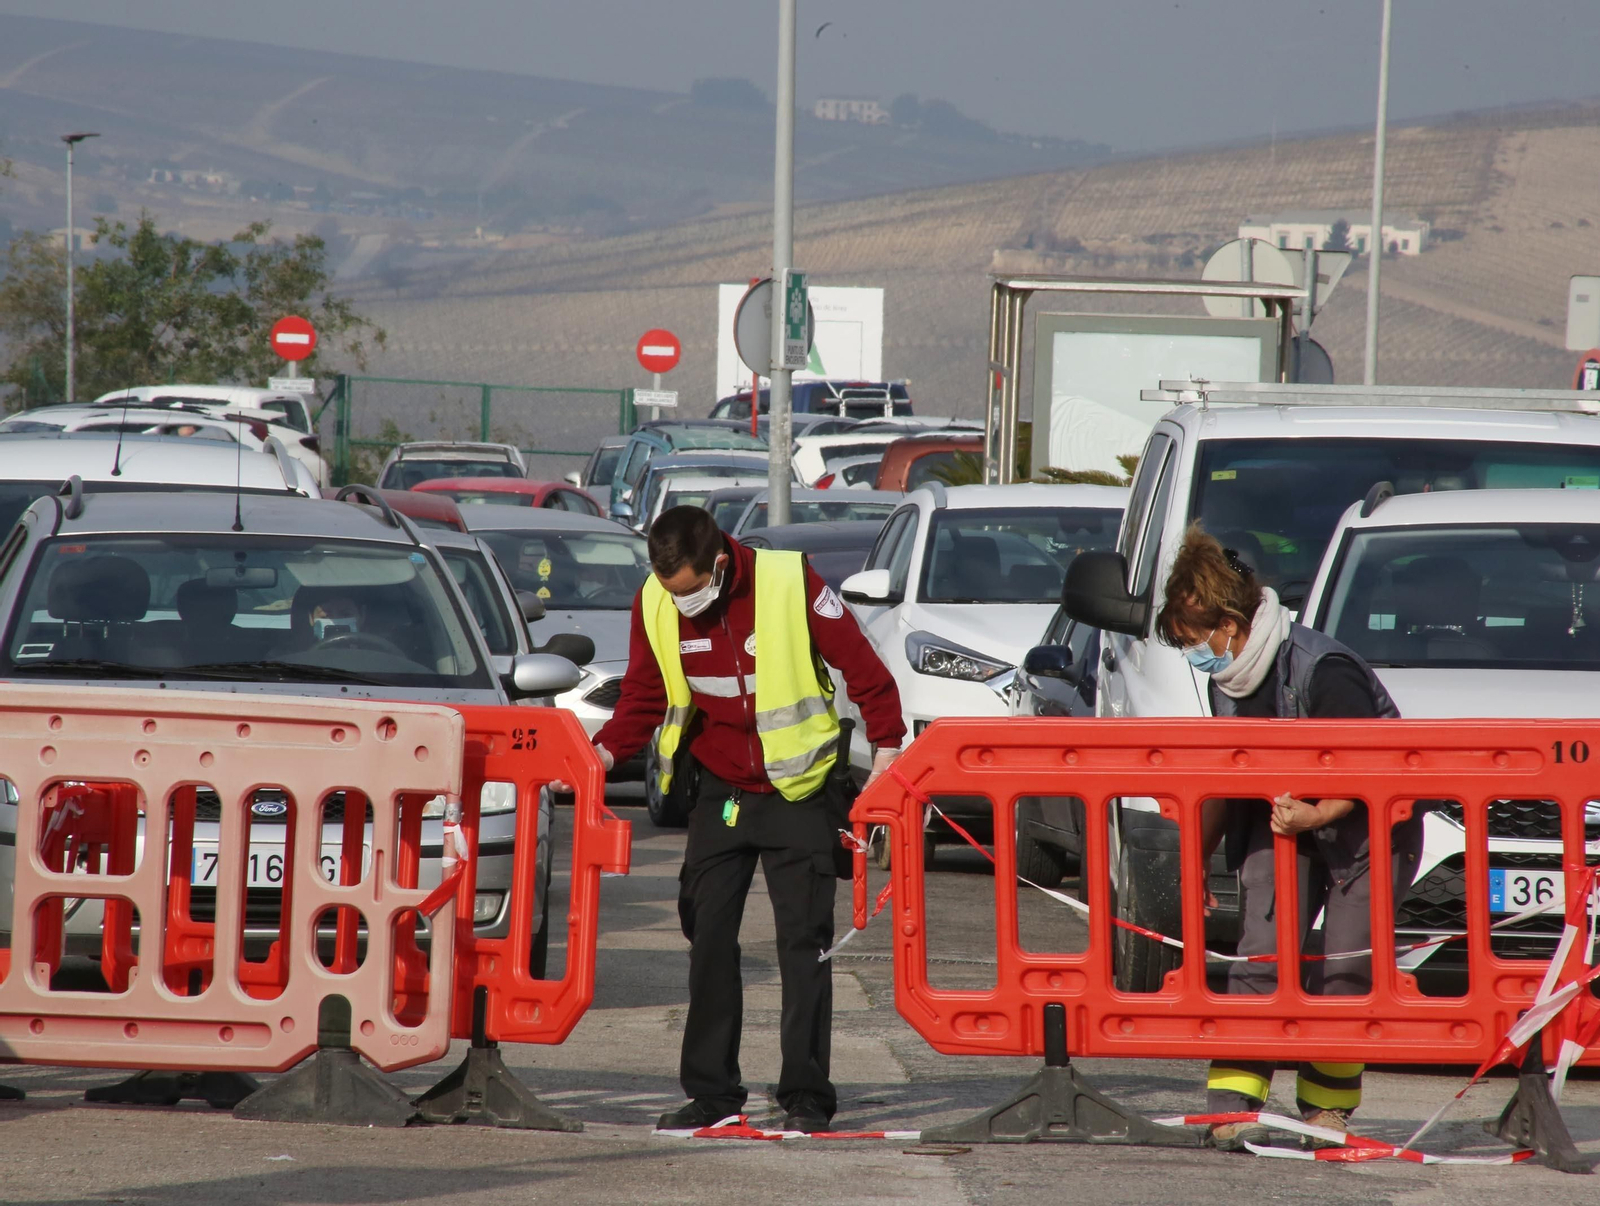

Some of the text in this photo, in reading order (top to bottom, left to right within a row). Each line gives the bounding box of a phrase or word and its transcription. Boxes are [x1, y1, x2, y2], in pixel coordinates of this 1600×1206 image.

[1551, 740, 1590, 764] 10
[258, 804, 280, 813] Ford
[203, 853, 284, 883] 716
[1492, 894, 1501, 904] E
